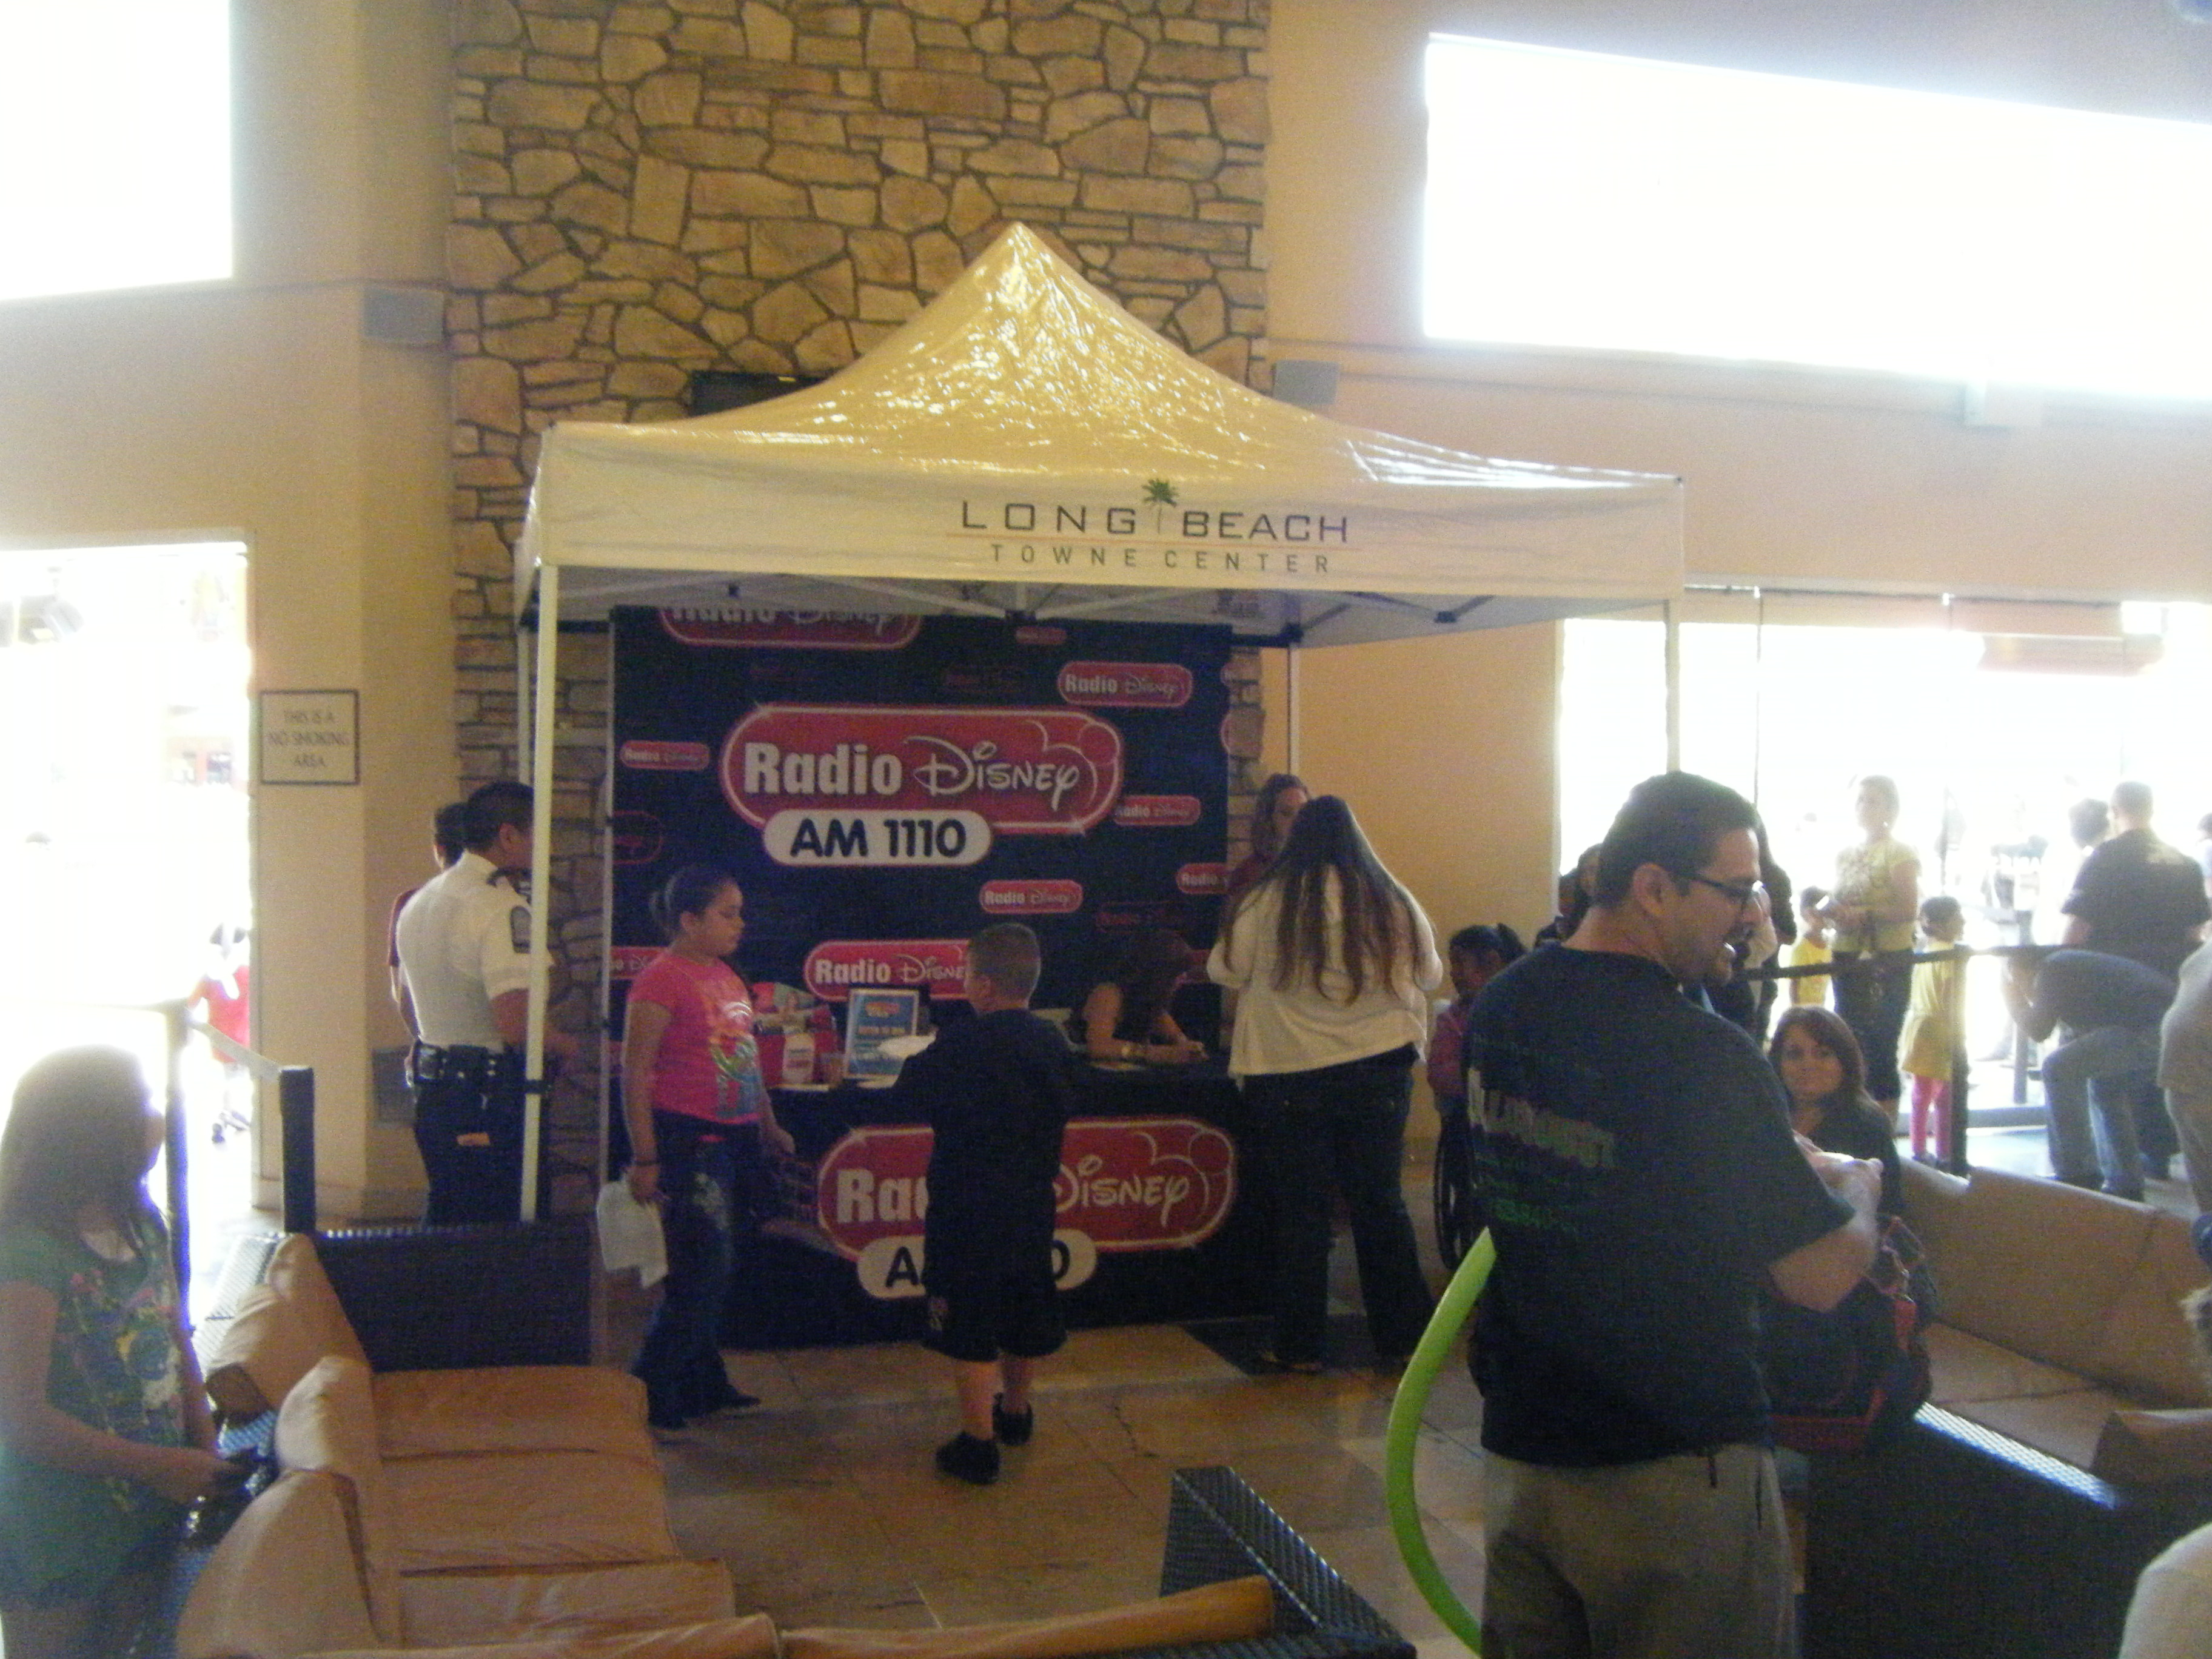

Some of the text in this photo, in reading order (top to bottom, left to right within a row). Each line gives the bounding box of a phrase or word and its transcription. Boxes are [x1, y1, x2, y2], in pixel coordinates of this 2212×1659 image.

[962, 501, 1348, 543] LONG BEACH
[991, 543, 1329, 573] TOWNE CENTER
[1065, 674, 1118, 693] Radio
[743, 742, 903, 796] Radio
[789, 818, 967, 858] AM 1110
[815, 958, 891, 984] Radio
